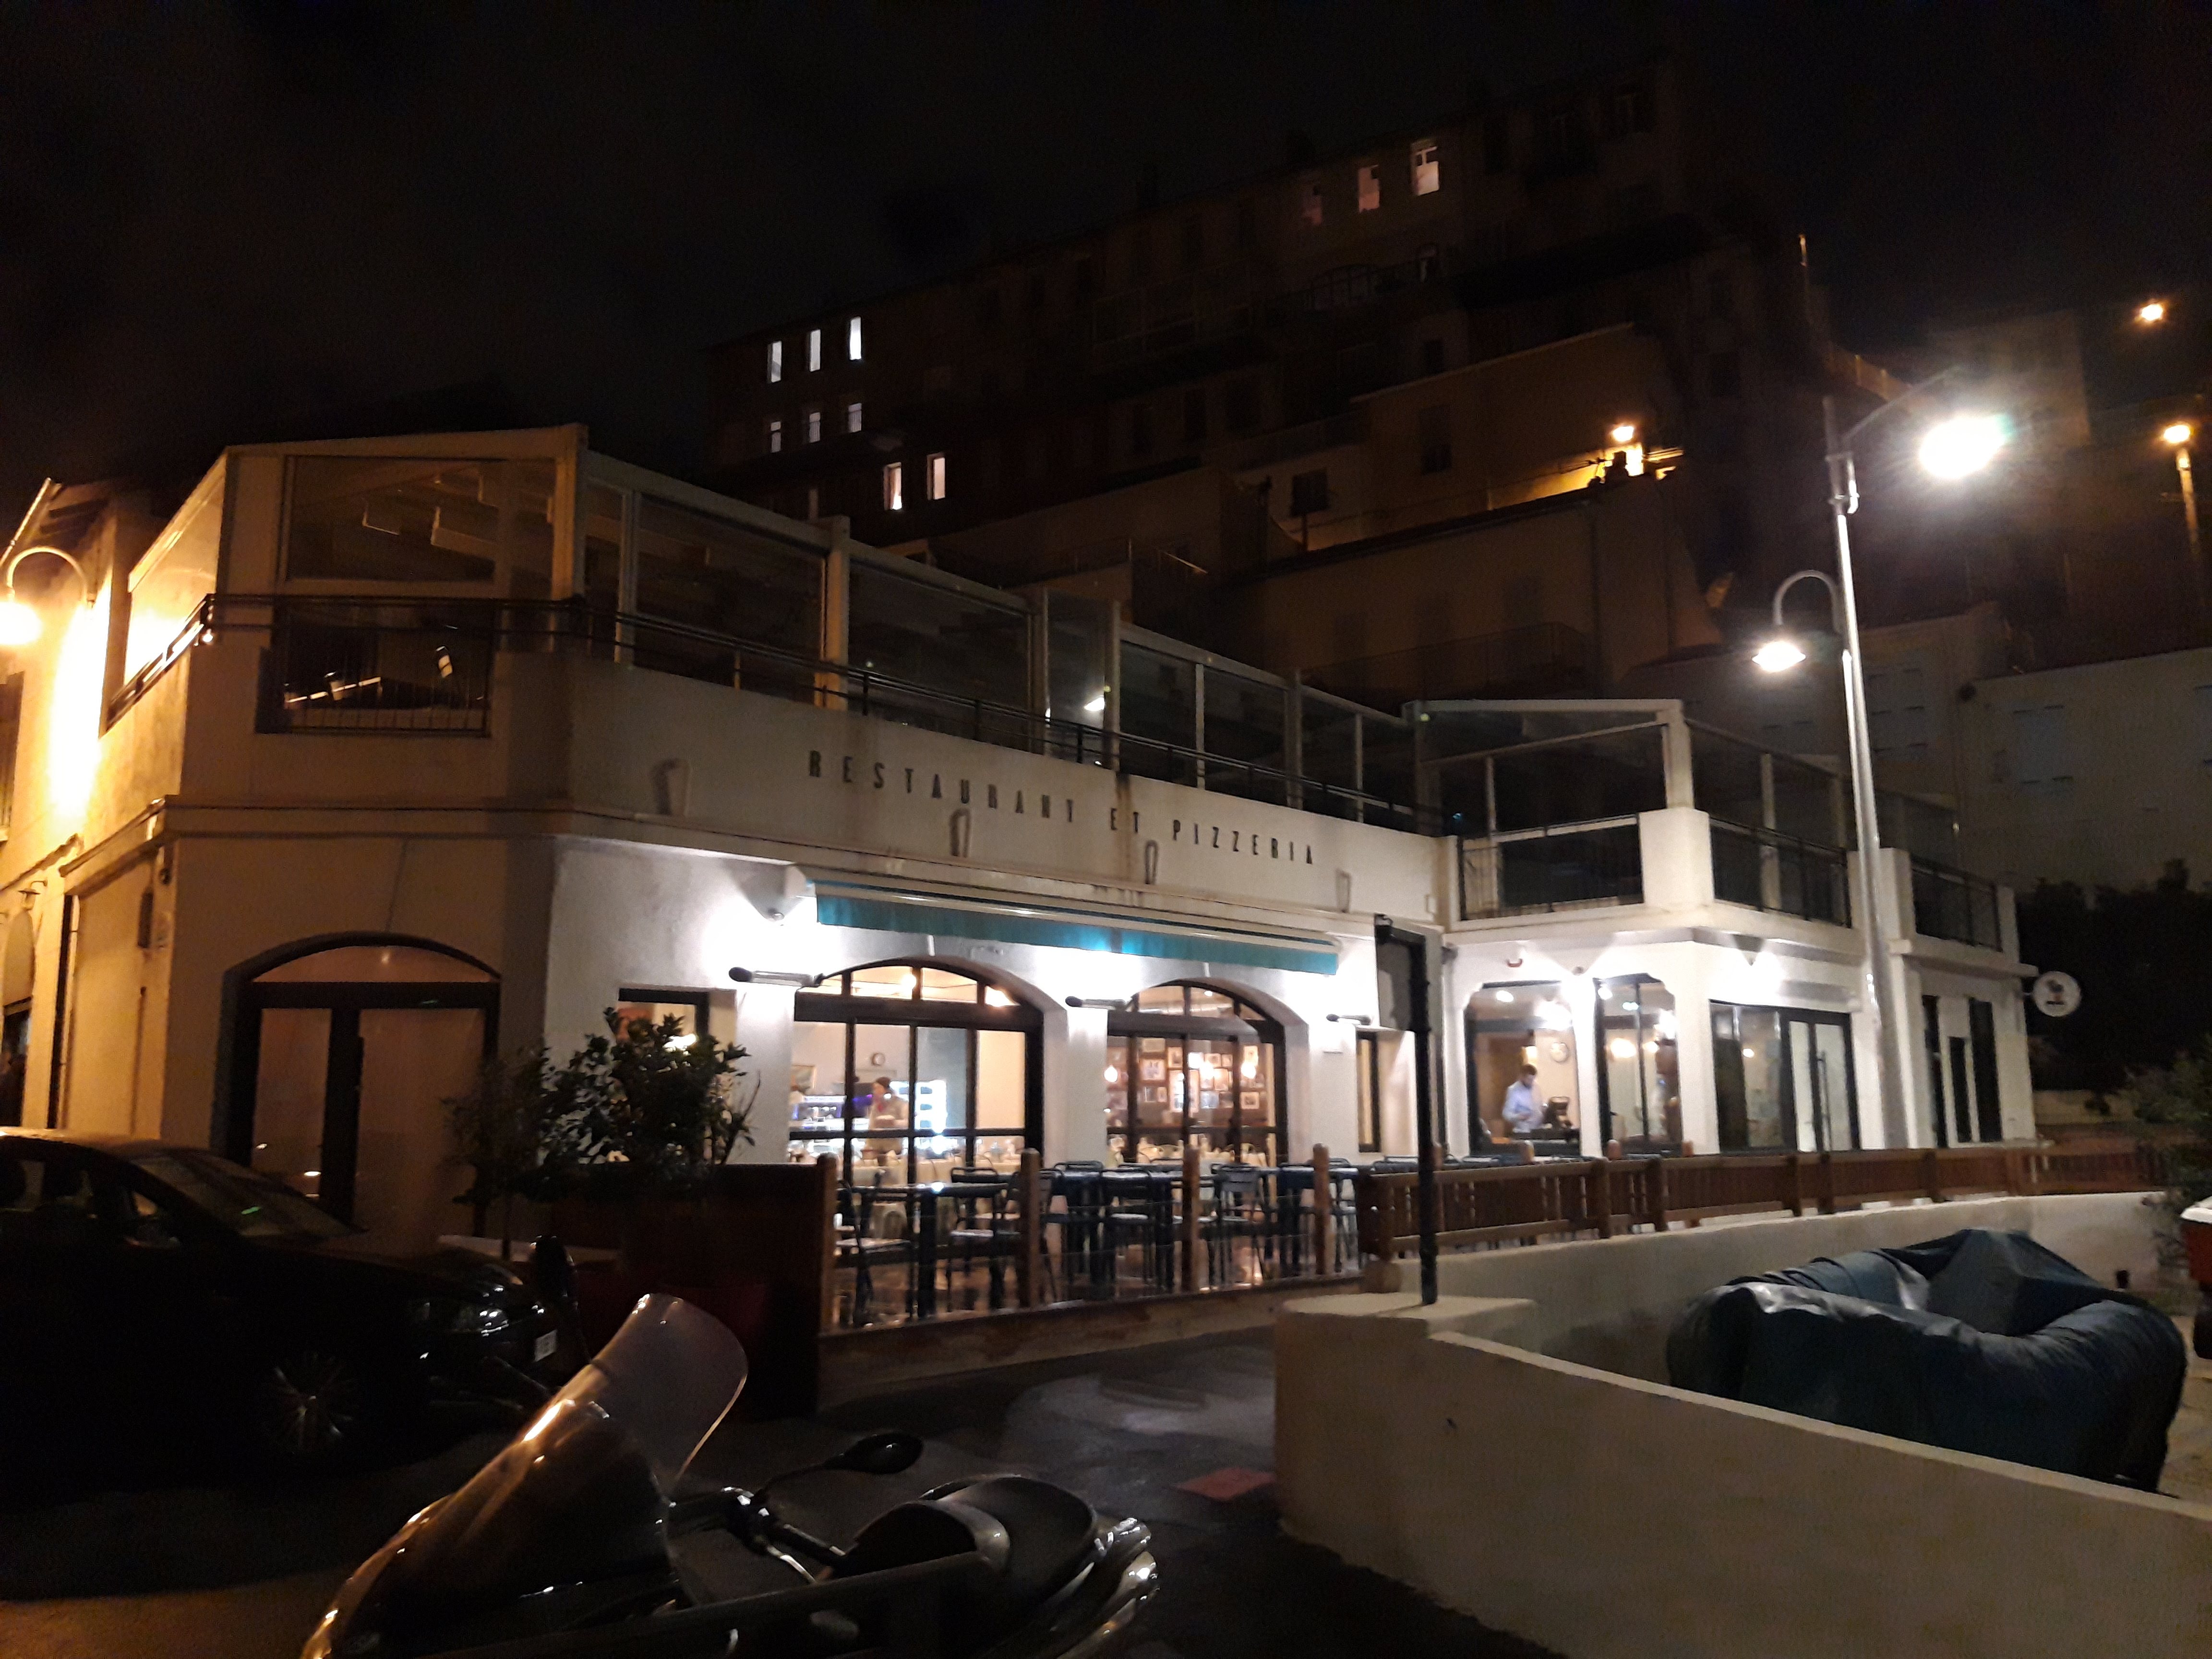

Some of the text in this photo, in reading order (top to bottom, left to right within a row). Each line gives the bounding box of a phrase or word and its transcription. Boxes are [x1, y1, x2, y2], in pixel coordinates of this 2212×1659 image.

[809, 750, 1313, 865] RESTAURANT ET PIZZERIA
